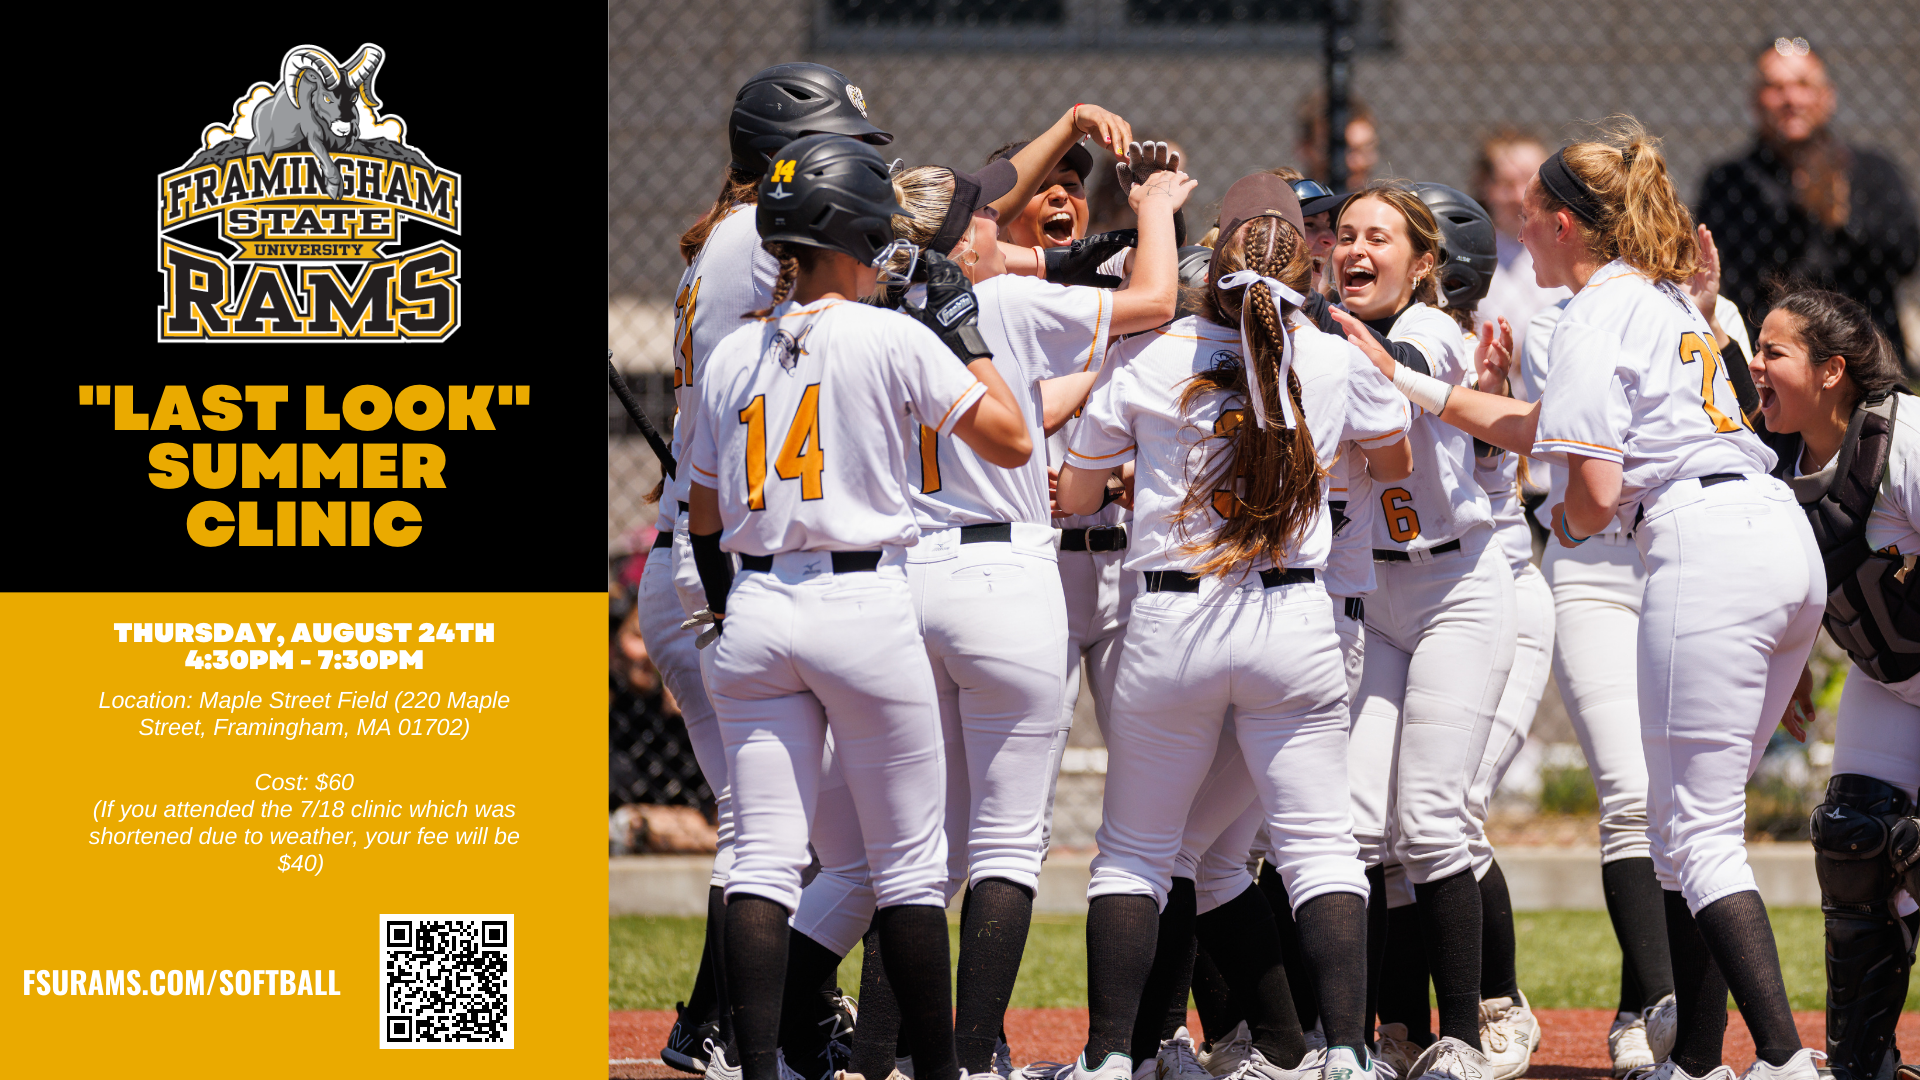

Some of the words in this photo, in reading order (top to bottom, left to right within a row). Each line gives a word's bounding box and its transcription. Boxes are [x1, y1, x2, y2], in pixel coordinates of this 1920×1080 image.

[770, 159, 797, 183] 14
[738, 383, 825, 512] 14
[1380, 487, 1421, 543] 6
